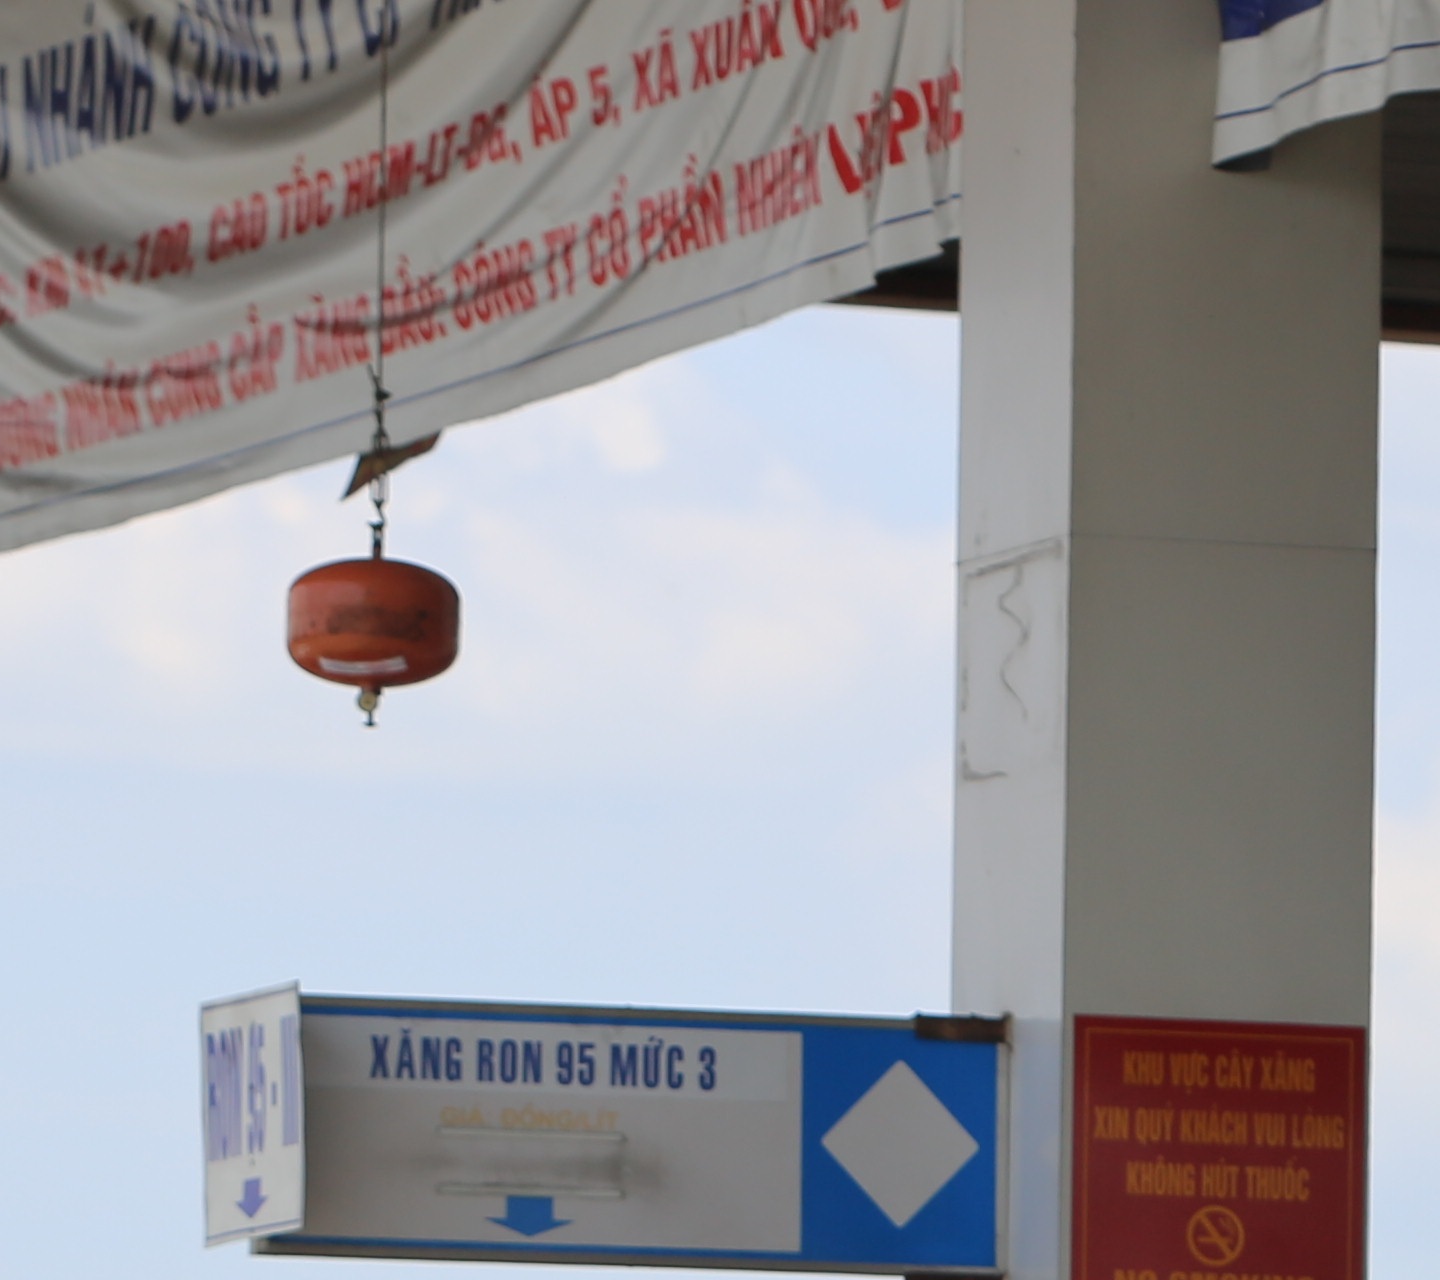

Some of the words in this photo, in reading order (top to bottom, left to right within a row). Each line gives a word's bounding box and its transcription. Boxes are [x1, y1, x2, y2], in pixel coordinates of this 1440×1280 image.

[631, 27, 679, 113] XÃ
[543, 221, 579, 303] TY
[369, 1028, 462, 1082] XĂNG
[477, 1037, 543, 1085] RON
[556, 1040, 597, 1087] 95
[610, 1034, 684, 1090] MỨC
[698, 1046, 718, 1091] 3
[1123, 1050, 1164, 1085] KHU
[1215, 1048, 1255, 1089] CÂY
[1095, 1105, 1129, 1142] XIN
[1126, 1155, 1196, 1196] KHÔNG
